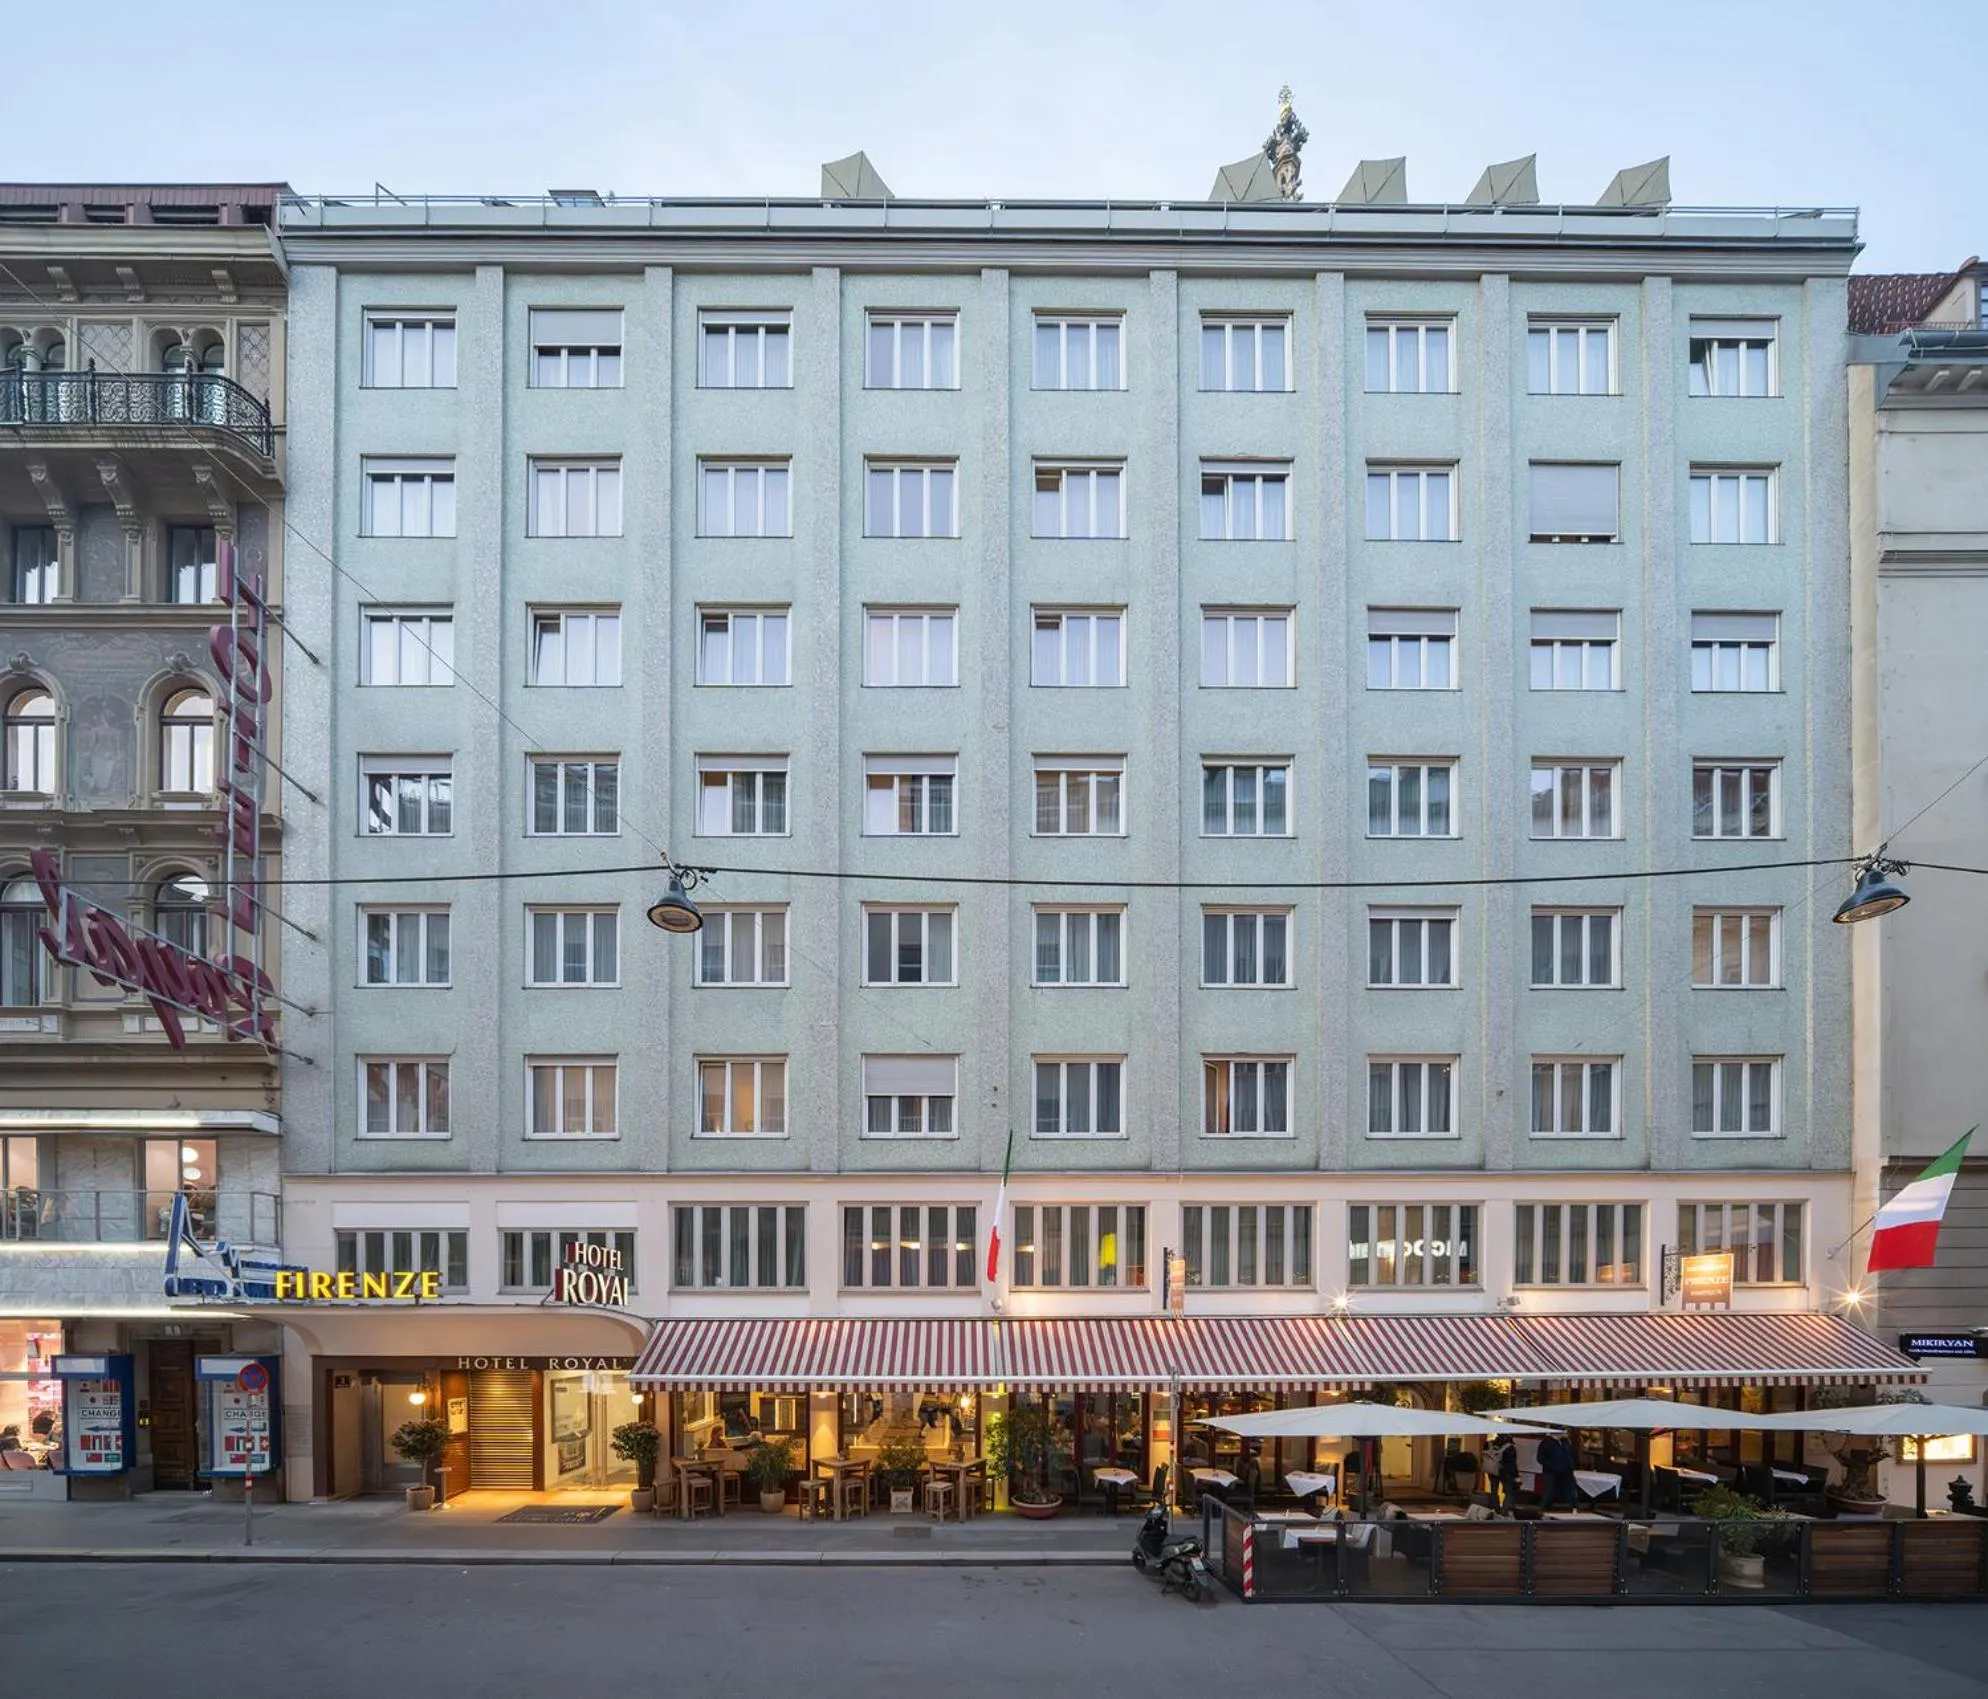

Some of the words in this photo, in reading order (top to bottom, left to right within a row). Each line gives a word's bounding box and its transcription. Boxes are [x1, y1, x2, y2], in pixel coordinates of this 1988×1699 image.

[574, 1241, 624, 1271] HOTEL
[275, 1271, 441, 1299] FIRENZE
[458, 1357, 529, 1370] HOTEL
[549, 1357, 622, 1370] ROYAL
